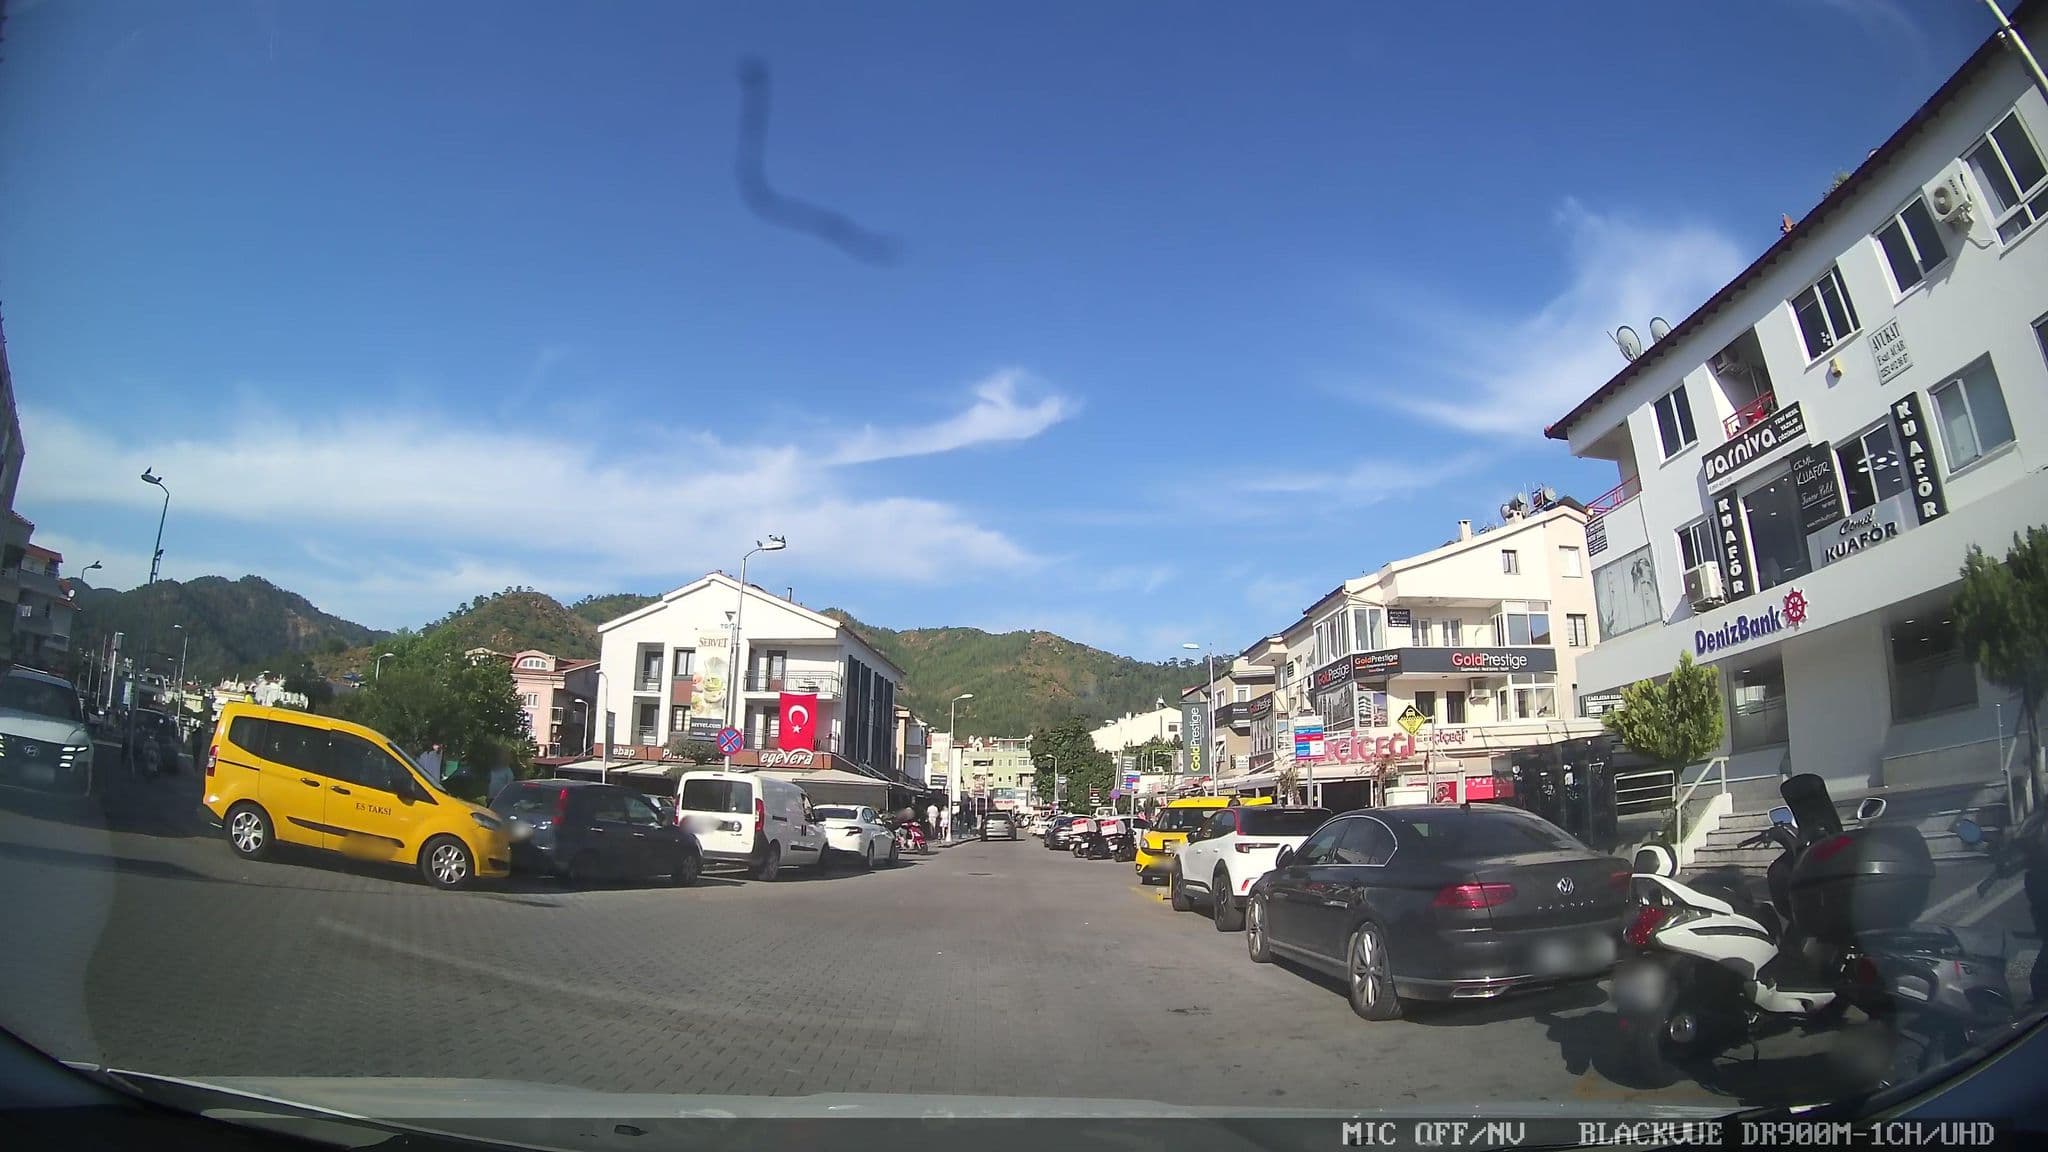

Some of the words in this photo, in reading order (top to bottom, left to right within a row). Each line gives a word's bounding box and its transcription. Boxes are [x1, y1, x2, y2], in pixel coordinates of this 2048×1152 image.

[1896, 401, 1938, 518] KUAFÖR
[1718, 498, 1745, 594] KUAFÖR
[1825, 521, 1898, 562] KUAFÖR
[698, 637, 728, 648] SERVET
[1695, 605, 1784, 656] DenizBank
[1355, 653, 1398, 665] GoldPrestige
[1452, 652, 1528, 669] GoldPrestige
[1190, 707, 1202, 772] GoldPrestige
